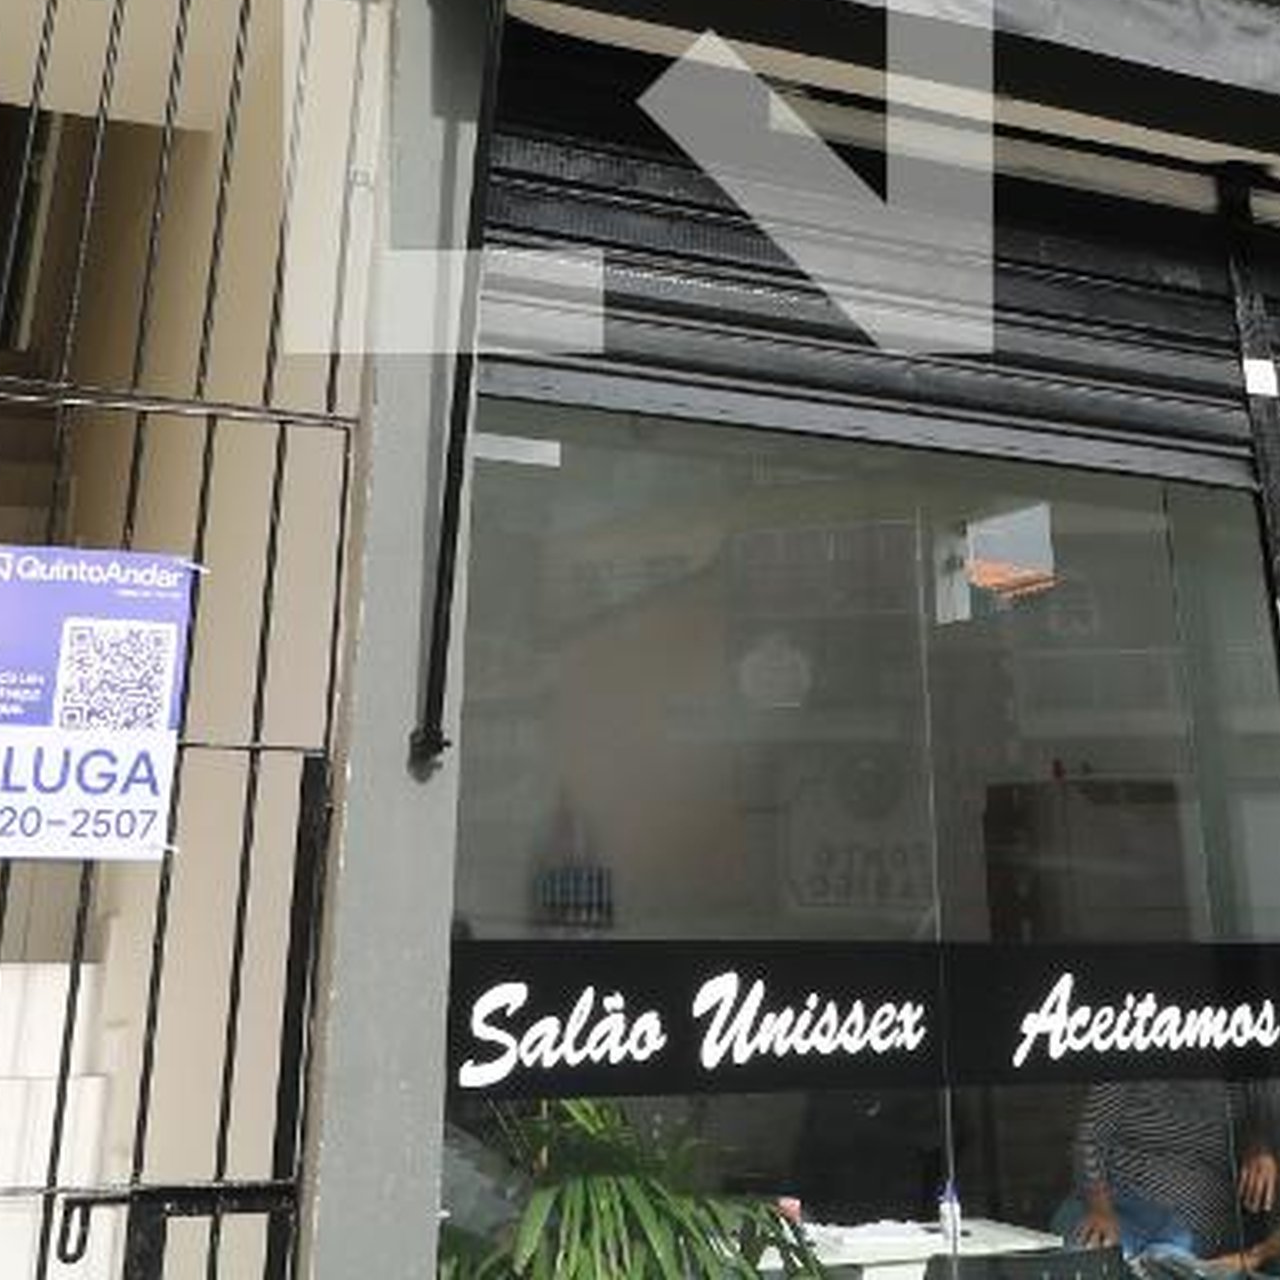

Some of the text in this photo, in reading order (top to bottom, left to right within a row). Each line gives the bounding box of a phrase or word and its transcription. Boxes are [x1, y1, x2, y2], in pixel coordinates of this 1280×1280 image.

[16, 555, 184, 589] QuintoAndar
[459, 971, 926, 1087] Salão Unissex
[1012, 972, 1280, 1068] Aceitamos
